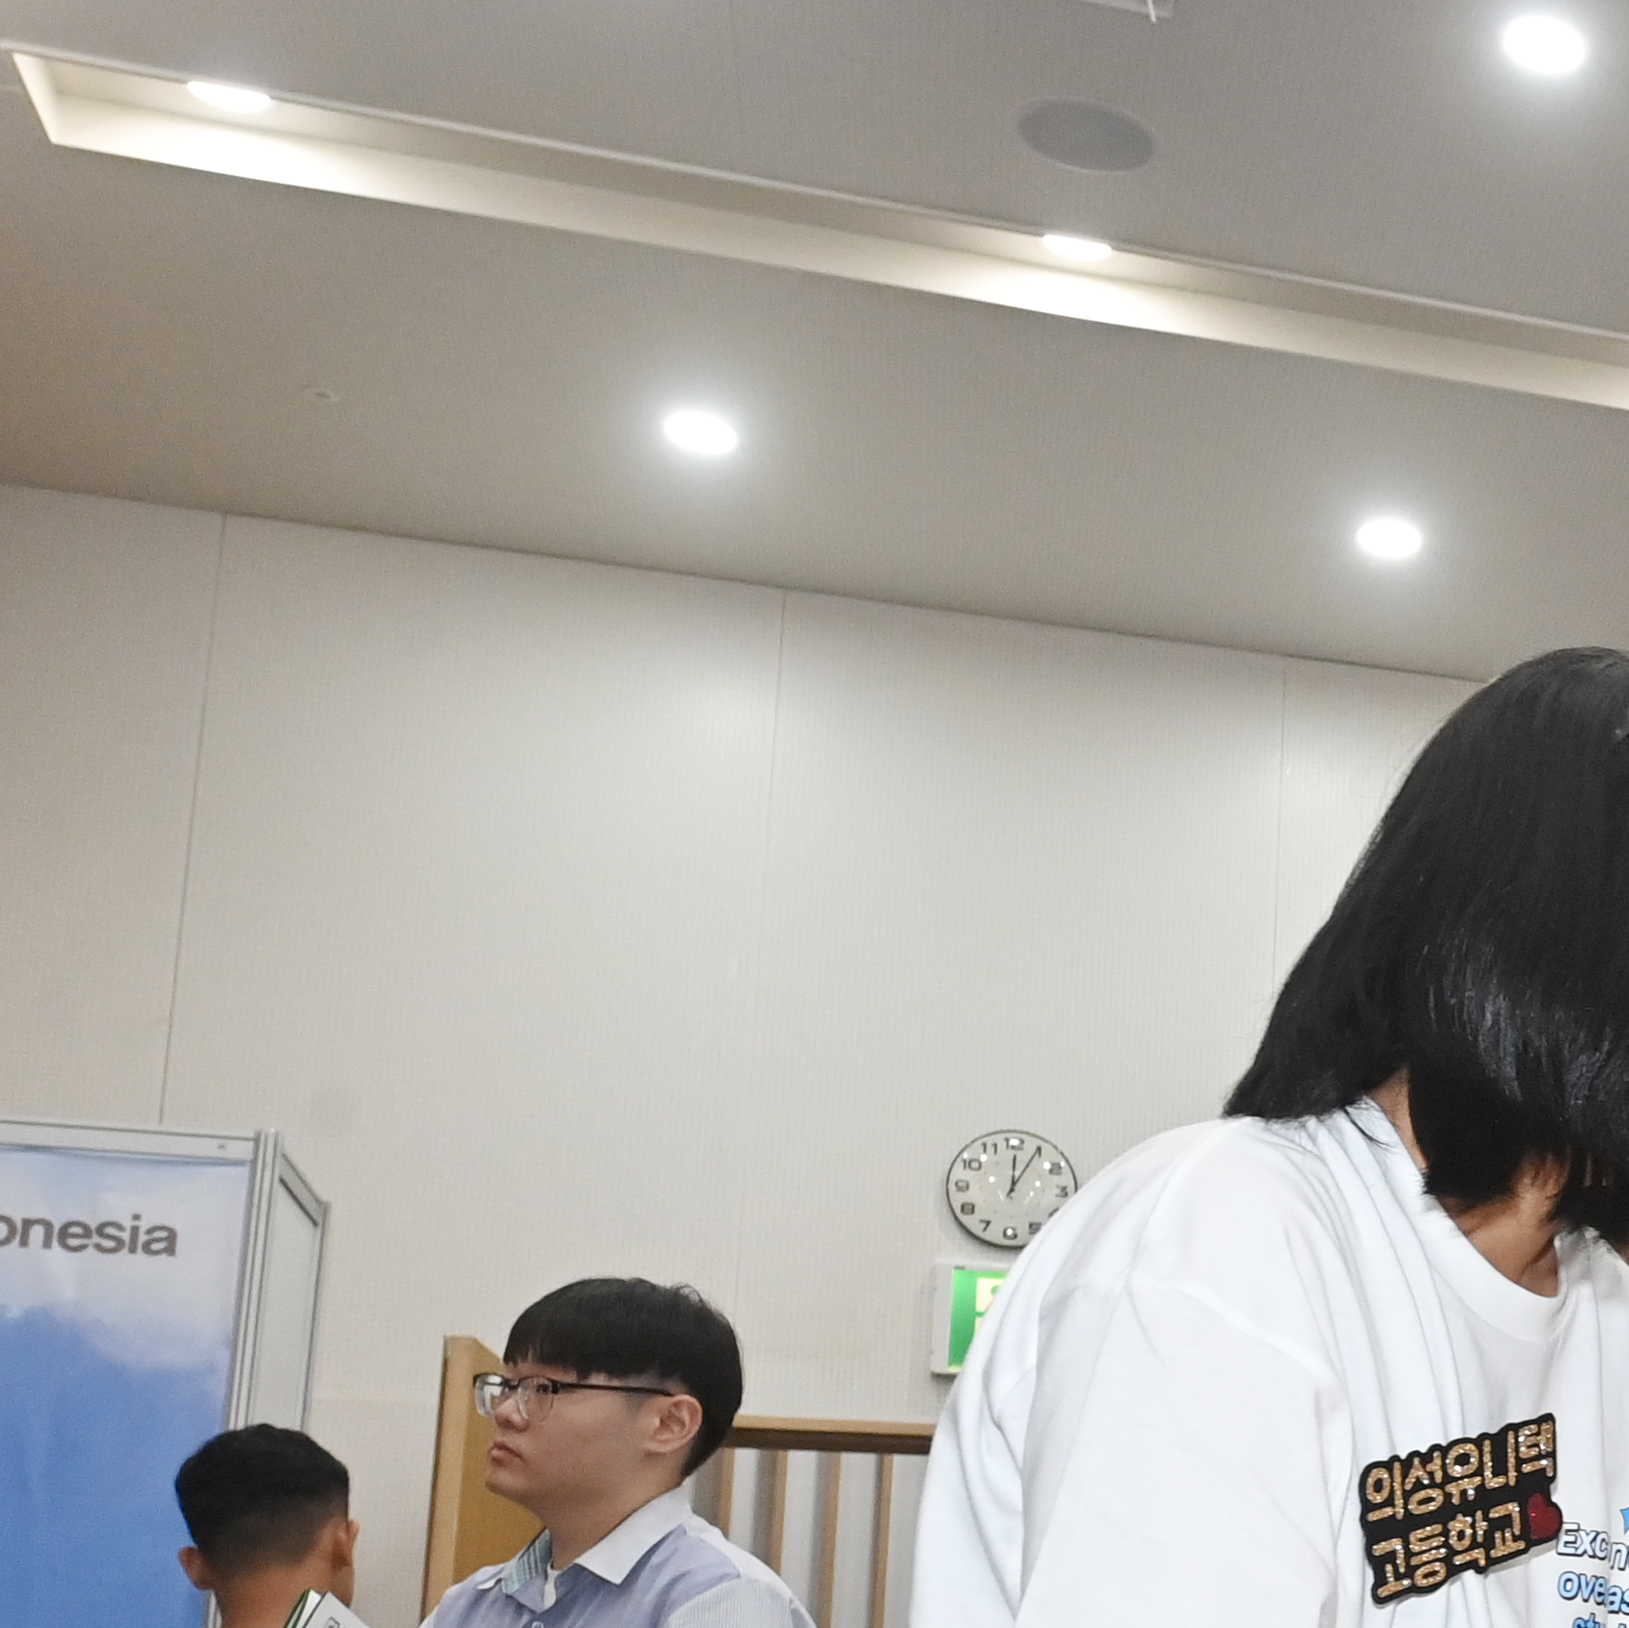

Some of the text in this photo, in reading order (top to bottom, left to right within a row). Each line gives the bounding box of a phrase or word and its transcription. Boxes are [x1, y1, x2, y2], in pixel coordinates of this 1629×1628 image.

[1004, 1137, 1025, 1151] 12
[961, 1158, 983, 1171] 10
[954, 1180, 970, 1193] 9
[1055, 1185, 1069, 1198] 3
[960, 1202, 975, 1216] 8
[979, 1219, 992, 1233] 7
[1028, 1222, 1042, 1236] 5
[1002, 1227, 1018, 1240] 6
[1365, 1420, 1555, 1522] 의성유니텍
[1371, 1500, 1527, 1599] 고등학교
